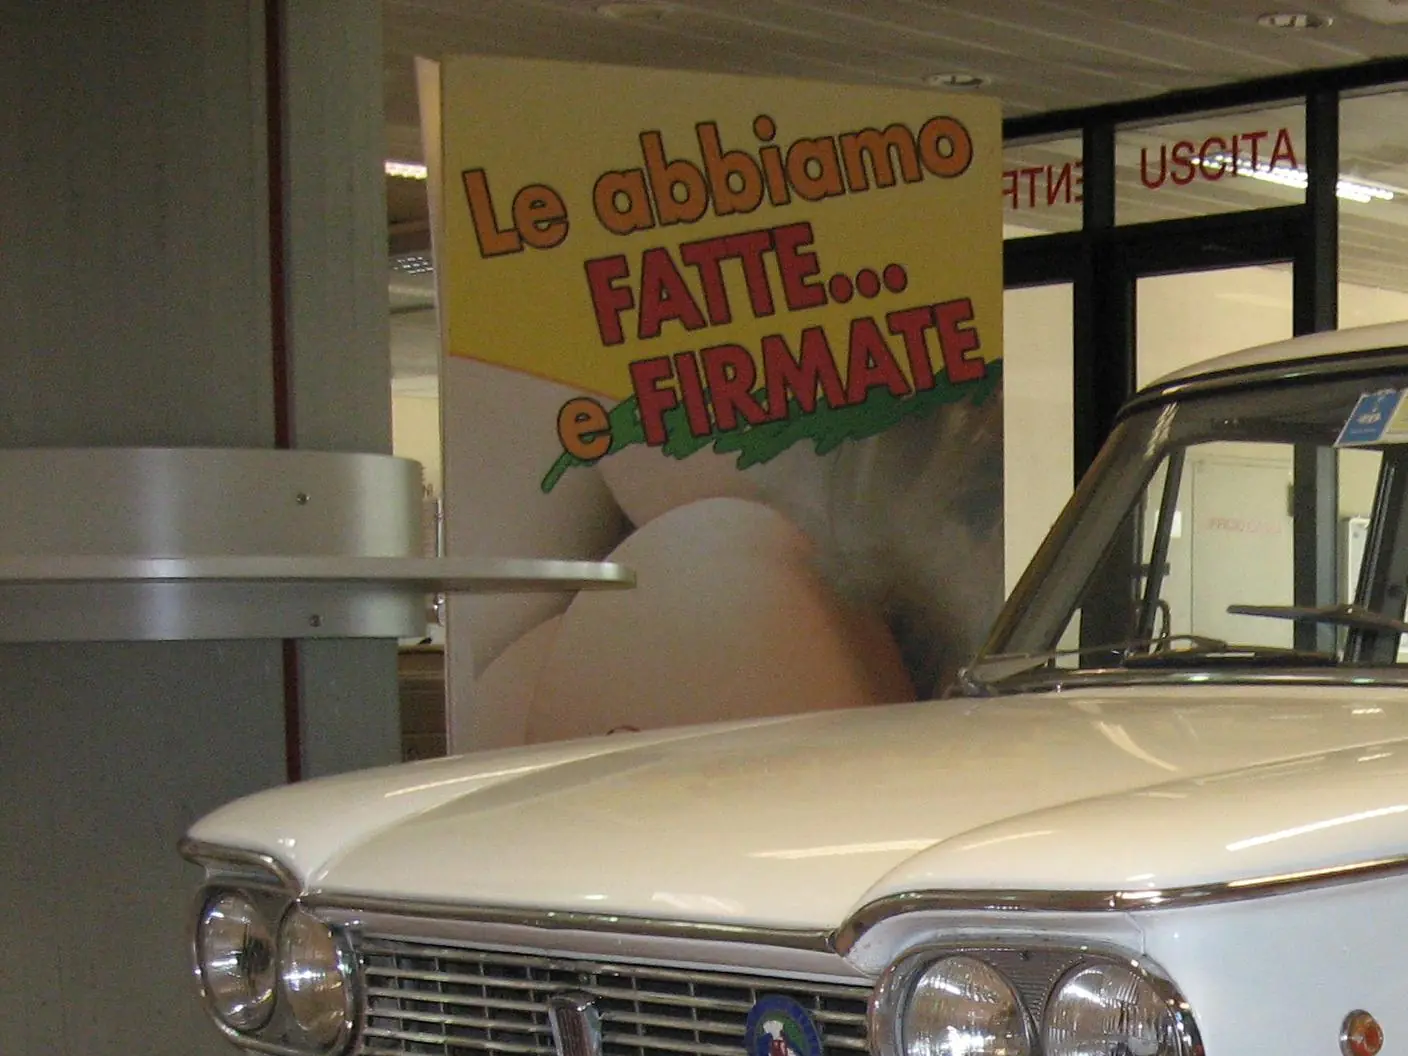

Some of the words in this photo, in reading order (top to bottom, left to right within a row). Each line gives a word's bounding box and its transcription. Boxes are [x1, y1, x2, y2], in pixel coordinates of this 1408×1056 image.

[462, 168, 570, 259] Le
[592, 114, 974, 236] abbiamo
[1139, 127, 1298, 190] USCITA
[583, 221, 908, 347] FATTE...
[557, 396, 613, 460] e
[629, 298, 987, 447] FIRMATE
